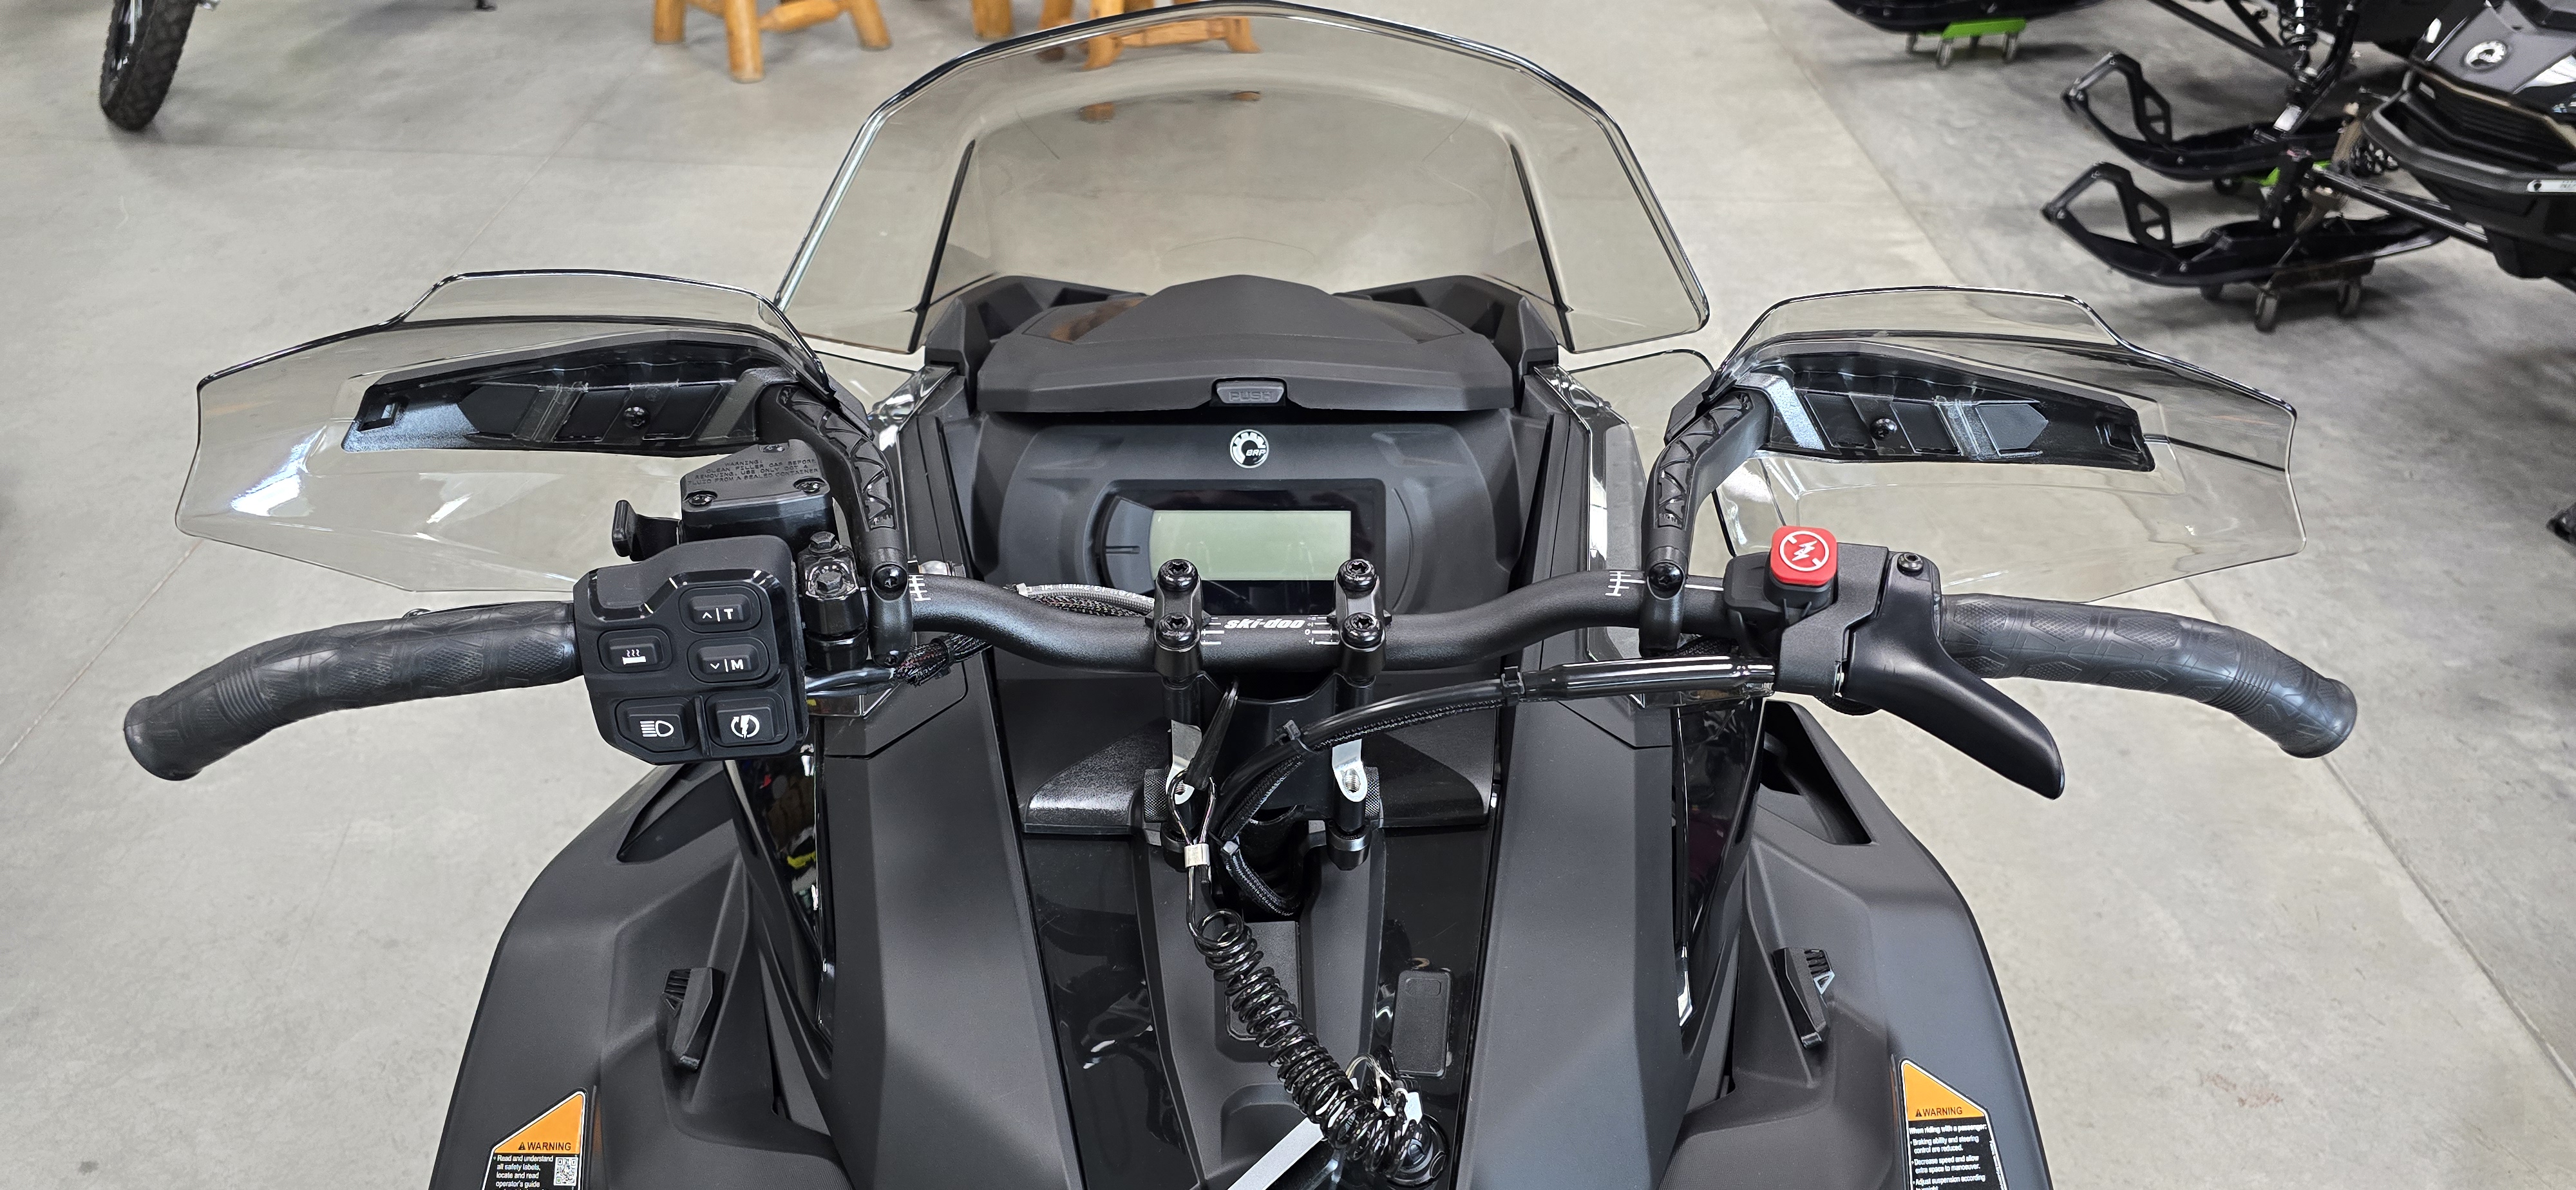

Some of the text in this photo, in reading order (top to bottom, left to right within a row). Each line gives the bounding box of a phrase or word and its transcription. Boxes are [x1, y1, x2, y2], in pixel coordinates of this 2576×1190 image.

[1228, 391, 1273, 402] PUSH
[775, 468, 818, 477] CONTAINER
[1224, 618, 1306, 629] ski-doo
[1922, 1106, 1963, 1117] WARNING
[1924, 1126, 1941, 1134] riding
[1912, 1138, 1932, 1146] Braking
[1932, 1137, 1947, 1145] ability
[1958, 1135, 1980, 1143] steering
[527, 1142, 571, 1151] WARNING
[1938, 1156, 1955, 1165] speed
[1955, 1155, 1965, 1163] and
[1915, 1174, 1986, 1186] Adjust suspension according
